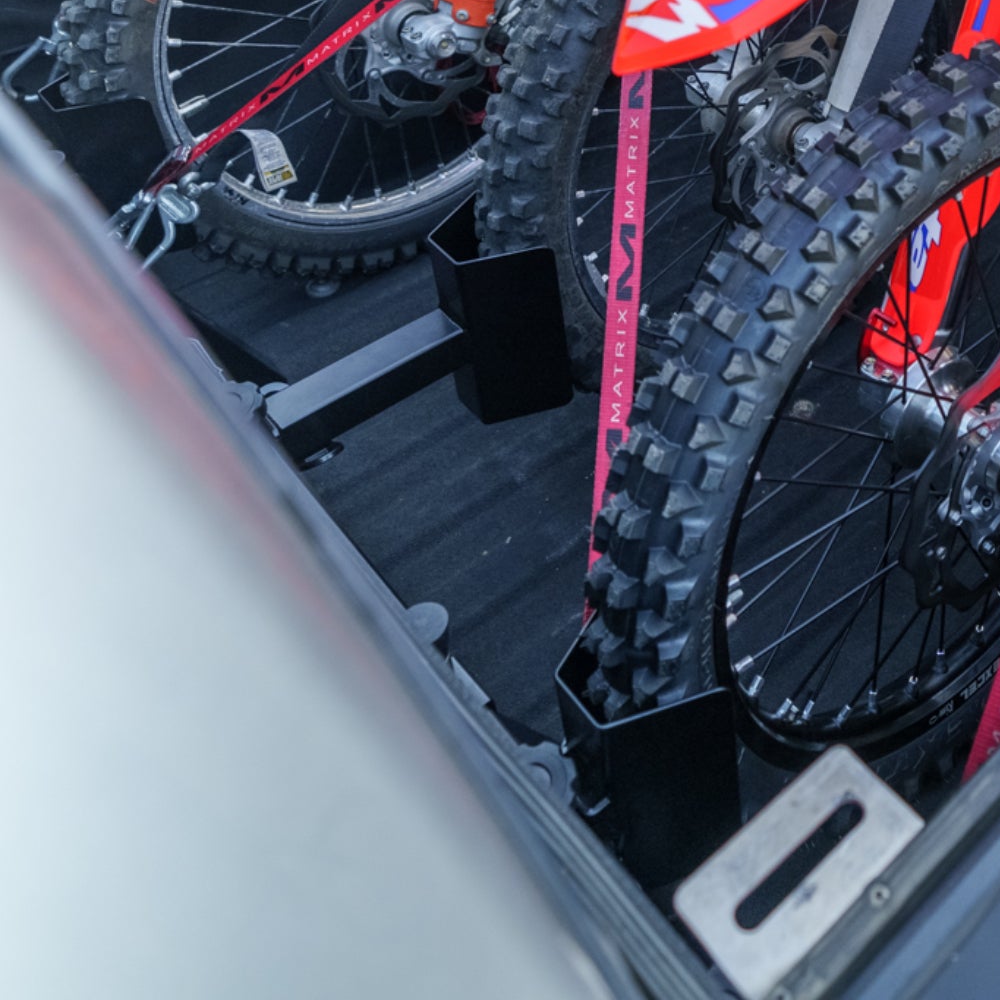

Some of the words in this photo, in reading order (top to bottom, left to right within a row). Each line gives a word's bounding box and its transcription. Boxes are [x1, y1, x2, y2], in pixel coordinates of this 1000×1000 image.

[305, 9, 372, 68] MATRIX
[624, 116, 640, 219] MATRIX
[610, 308, 629, 423] MATRIX
